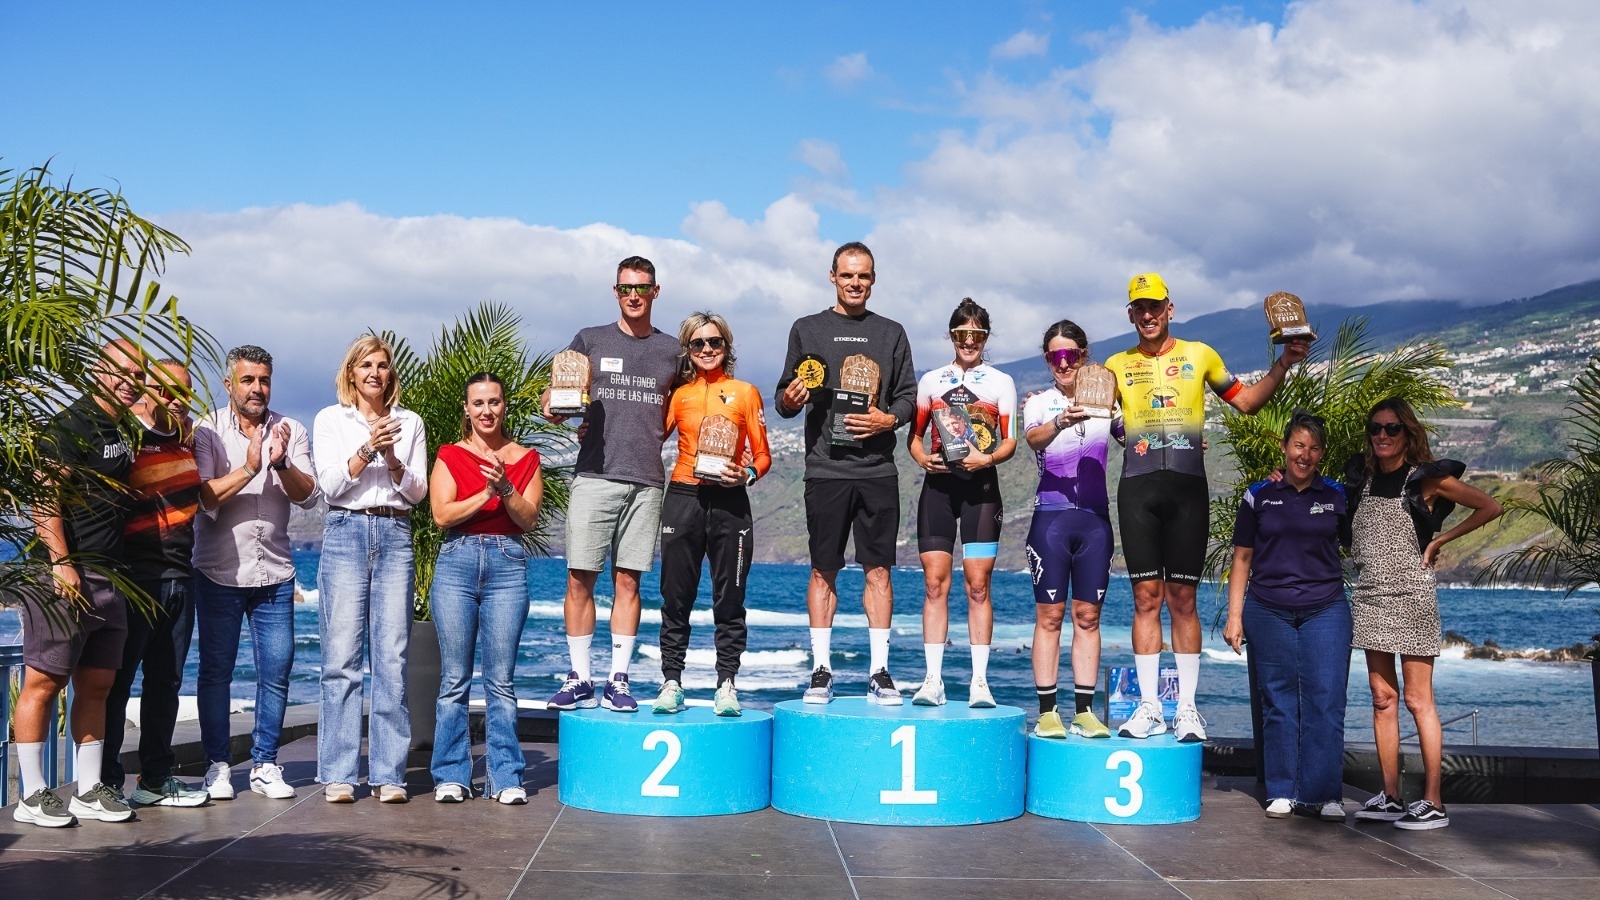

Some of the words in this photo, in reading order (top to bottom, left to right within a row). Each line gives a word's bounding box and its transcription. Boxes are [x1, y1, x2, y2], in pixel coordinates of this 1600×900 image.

[610, 373, 631, 386] GRAN
[632, 375, 657, 389] FONDO
[847, 379, 870, 388] TEIDE
[596, 387, 615, 399] PICO
[616, 389, 627, 401] DE
[628, 390, 642, 402] LAS
[642, 391, 665, 406] NIEVES
[1081, 390, 1106, 399] TEIDE
[705, 439, 729, 449] TEIDE
[641, 730, 681, 797] 2
[880, 725, 937, 804] 1
[1104, 750, 1143, 817] 3
